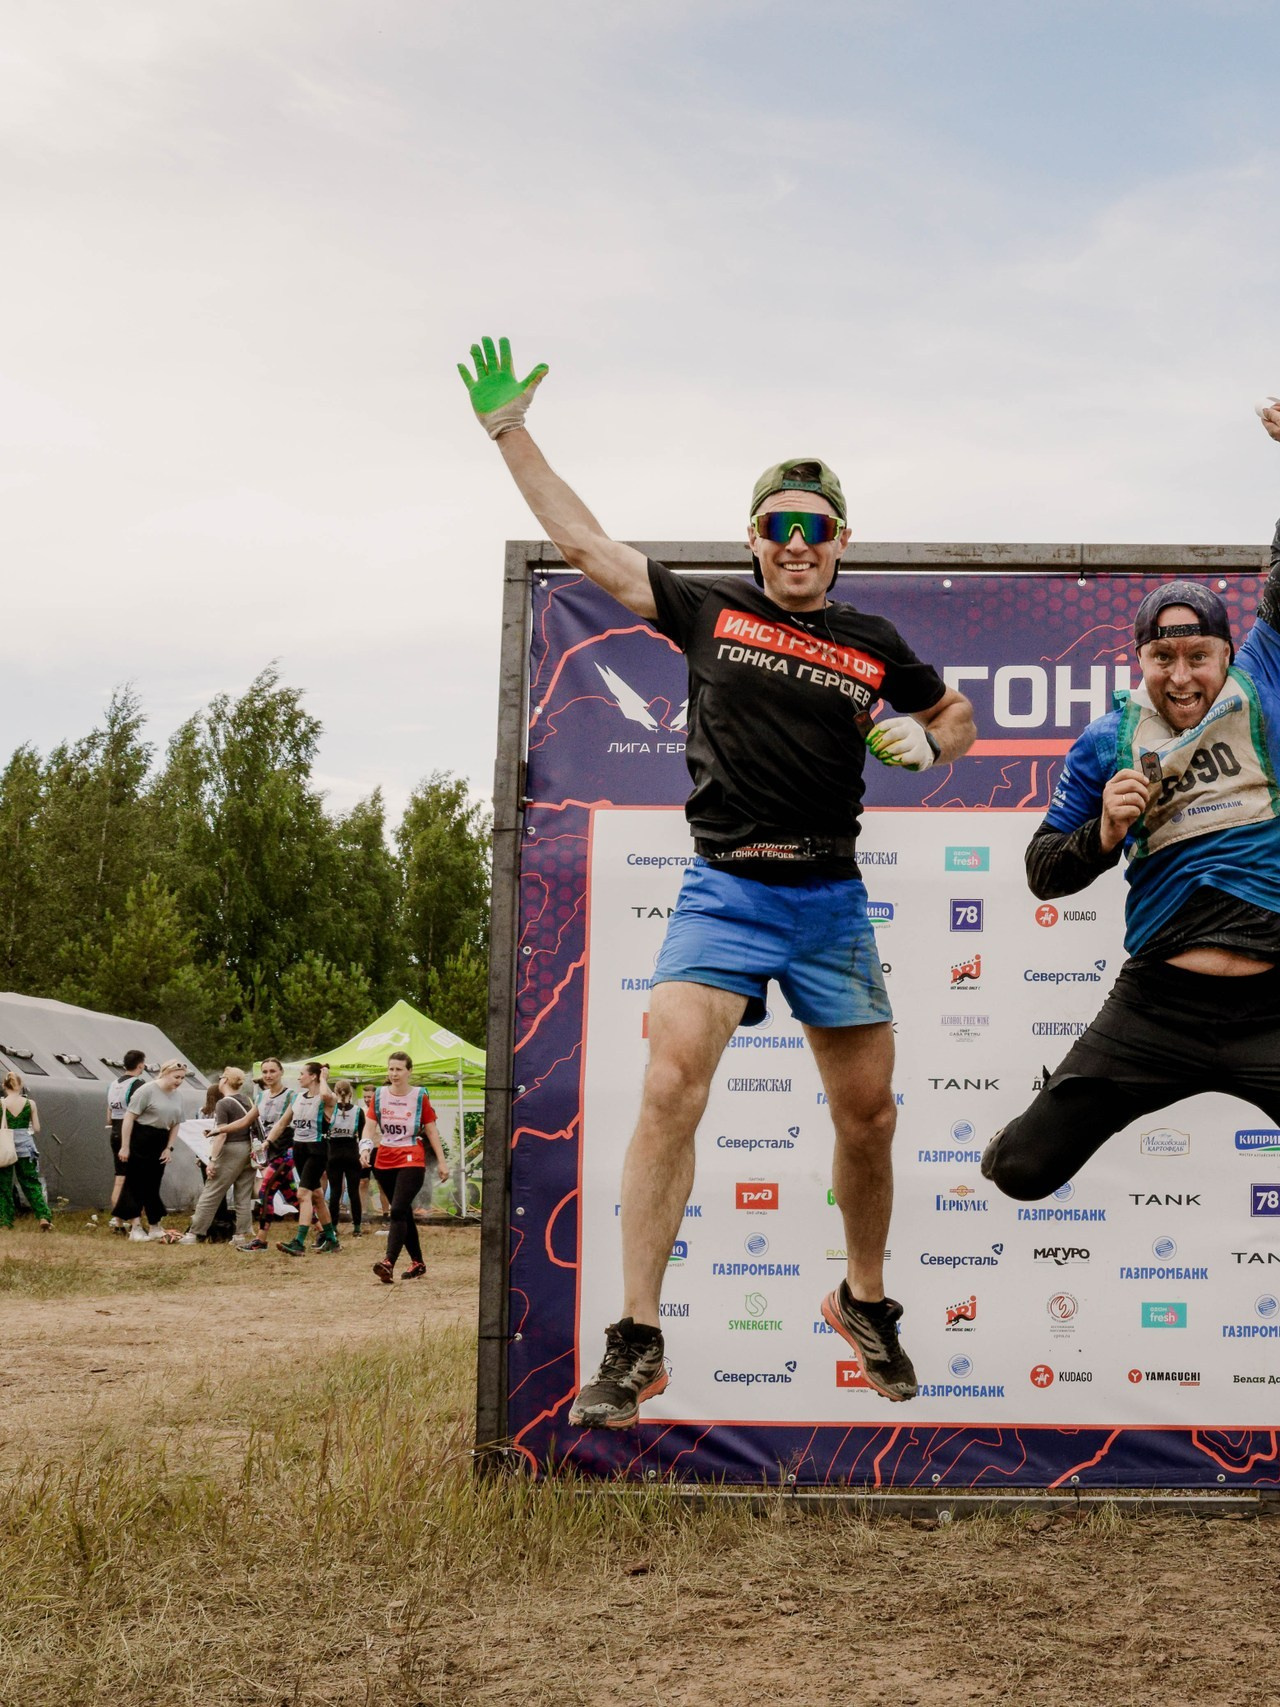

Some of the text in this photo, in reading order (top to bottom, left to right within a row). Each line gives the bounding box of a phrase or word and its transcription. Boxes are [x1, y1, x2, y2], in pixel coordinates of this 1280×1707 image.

[722, 615, 879, 679] ИНСТРУКТОР
[717, 644, 872, 707] ГОНКА ГЕРОЕВ
[943, 665, 1144, 728] ГОН
[607, 742, 687, 753] ЛИГА ГЕР
[1187, 800, 1243, 816] ГАЗПРОМБАНК
[731, 849, 795, 859] ГОНКА ГЕРОЕВ
[856, 851, 898, 865] ЕЖСКАЯ
[953, 855, 979, 866] fresh
[631, 906, 675, 918] TAN
[955, 907, 978, 925] 78
[1063, 910, 1097, 922] KUDAGO
[950, 954, 982, 986] NRJ
[1023, 969, 1101, 985] Северсталь
[963, 1016, 976, 1025] FREE
[977, 1016, 989, 1025] WINE
[1032, 1021, 1088, 1036] СЕНЕЖСКА
[726, 1036, 805, 1049] ЗПРОМБАНК
[727, 1078, 792, 1093] СЕНЕЖСКАЯ
[928, 1078, 1000, 1090] TANK
[717, 1136, 794, 1151] Северсталь
[1142, 1136, 1187, 1147] Московский
[1147, 1145, 1184, 1153] КАРТОФЕЛЬ
[918, 1150, 981, 1163] ГАЗПРОМБ
[1128, 1194, 1201, 1206] TANK
[1256, 1190, 1279, 1210] 78
[1018, 1208, 1106, 1221] ГАЗПРОМБАНК
[920, 1252, 998, 1268] Северсталь
[1034, 1247, 1090, 1260] МАГУРО
[712, 1263, 800, 1276] ГАЗПРОМБАНК
[1120, 1267, 1208, 1280] ГАЗПРОМБАНК
[945, 1295, 977, 1327] NRJ
[1150, 1310, 1175, 1322] fresh
[728, 1319, 783, 1331] SYNERGETIC
[713, 1369, 791, 1386] Северсталь
[1058, 1371, 1093, 1382] KUDAGO
[1145, 1371, 1201, 1381] YAMAGUCHI
[1232, 1374, 1266, 1383] Белая
[917, 1384, 1005, 1398] ГАЗПРОМБАНК
